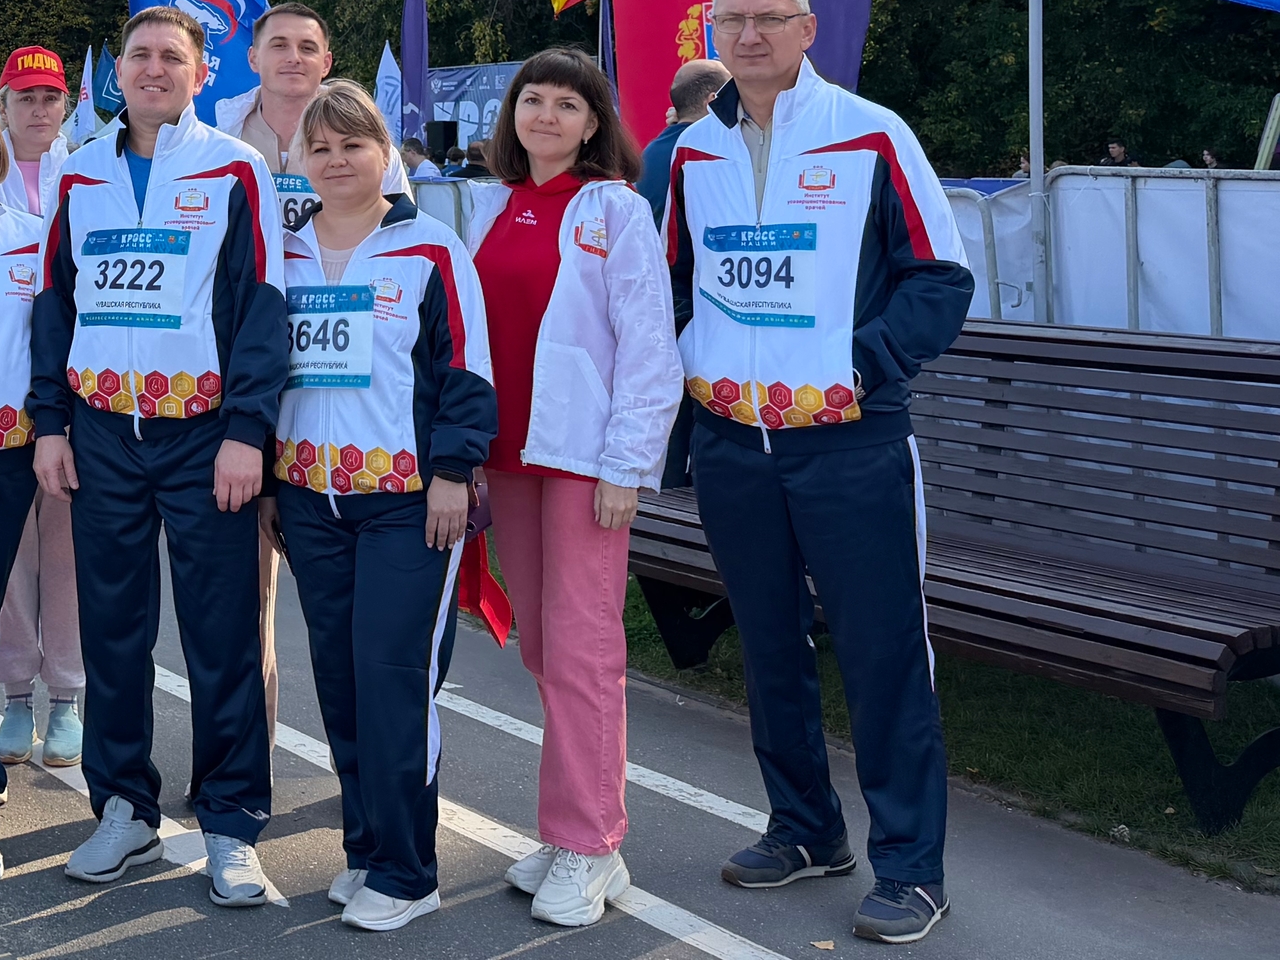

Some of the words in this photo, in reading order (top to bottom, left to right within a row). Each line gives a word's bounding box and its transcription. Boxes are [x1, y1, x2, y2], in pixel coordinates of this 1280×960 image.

[18, 53, 59, 72] ГИДУВ
[273, 178, 302, 186] РОСС
[121, 233, 152, 243] КРОСС
[741, 231, 776, 241] КРОСС
[94, 258, 165, 290] 3222
[717, 256, 794, 289] 3094
[301, 294, 336, 303] КРОСС
[125, 301, 161, 309] РЕСПУБЛИКА
[752, 301, 792, 309] РЕСПУБЛИКА
[310, 360, 348, 369] РЕСПУБЛИКА
